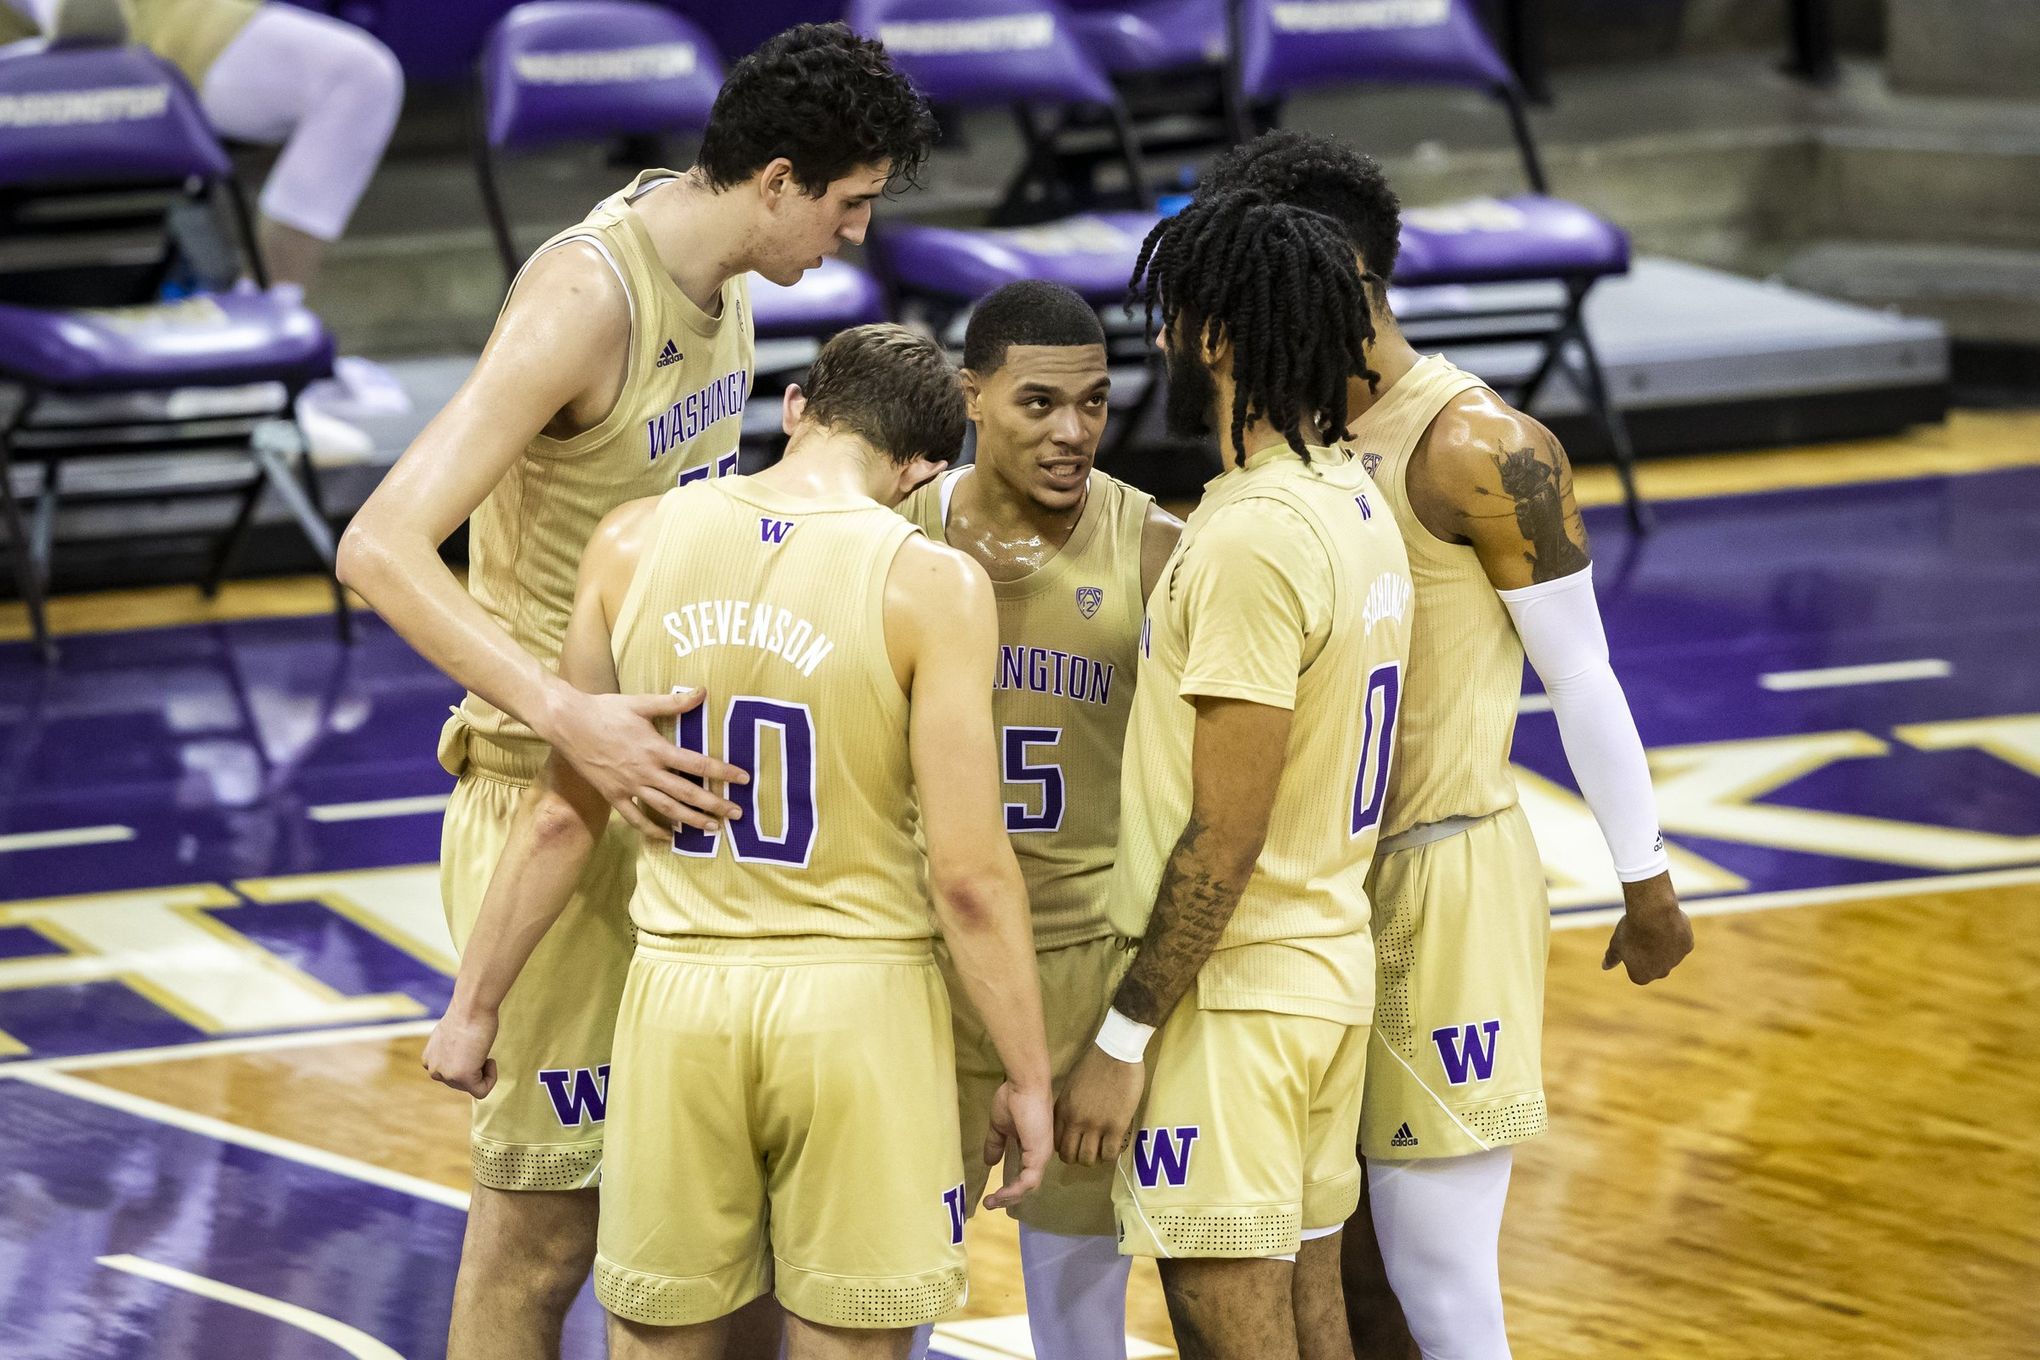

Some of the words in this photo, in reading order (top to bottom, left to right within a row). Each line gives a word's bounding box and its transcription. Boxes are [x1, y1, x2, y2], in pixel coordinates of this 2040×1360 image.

[656, 353, 684, 368] adidas
[759, 517, 794, 545] W
[1355, 494, 1371, 521] W
[1079, 588, 1101, 606] PAC
[662, 598, 834, 678] STEVENSON
[993, 645, 1115, 705] NGTON
[671, 685, 818, 869] 10
[1003, 726, 1066, 833] 5
[1349, 659, 1401, 841] 0
[1432, 1018, 1501, 1086] W
[538, 1064, 611, 1127] W
[1133, 1125, 1200, 1189] W
[1391, 1137, 1419, 1147] adidas
